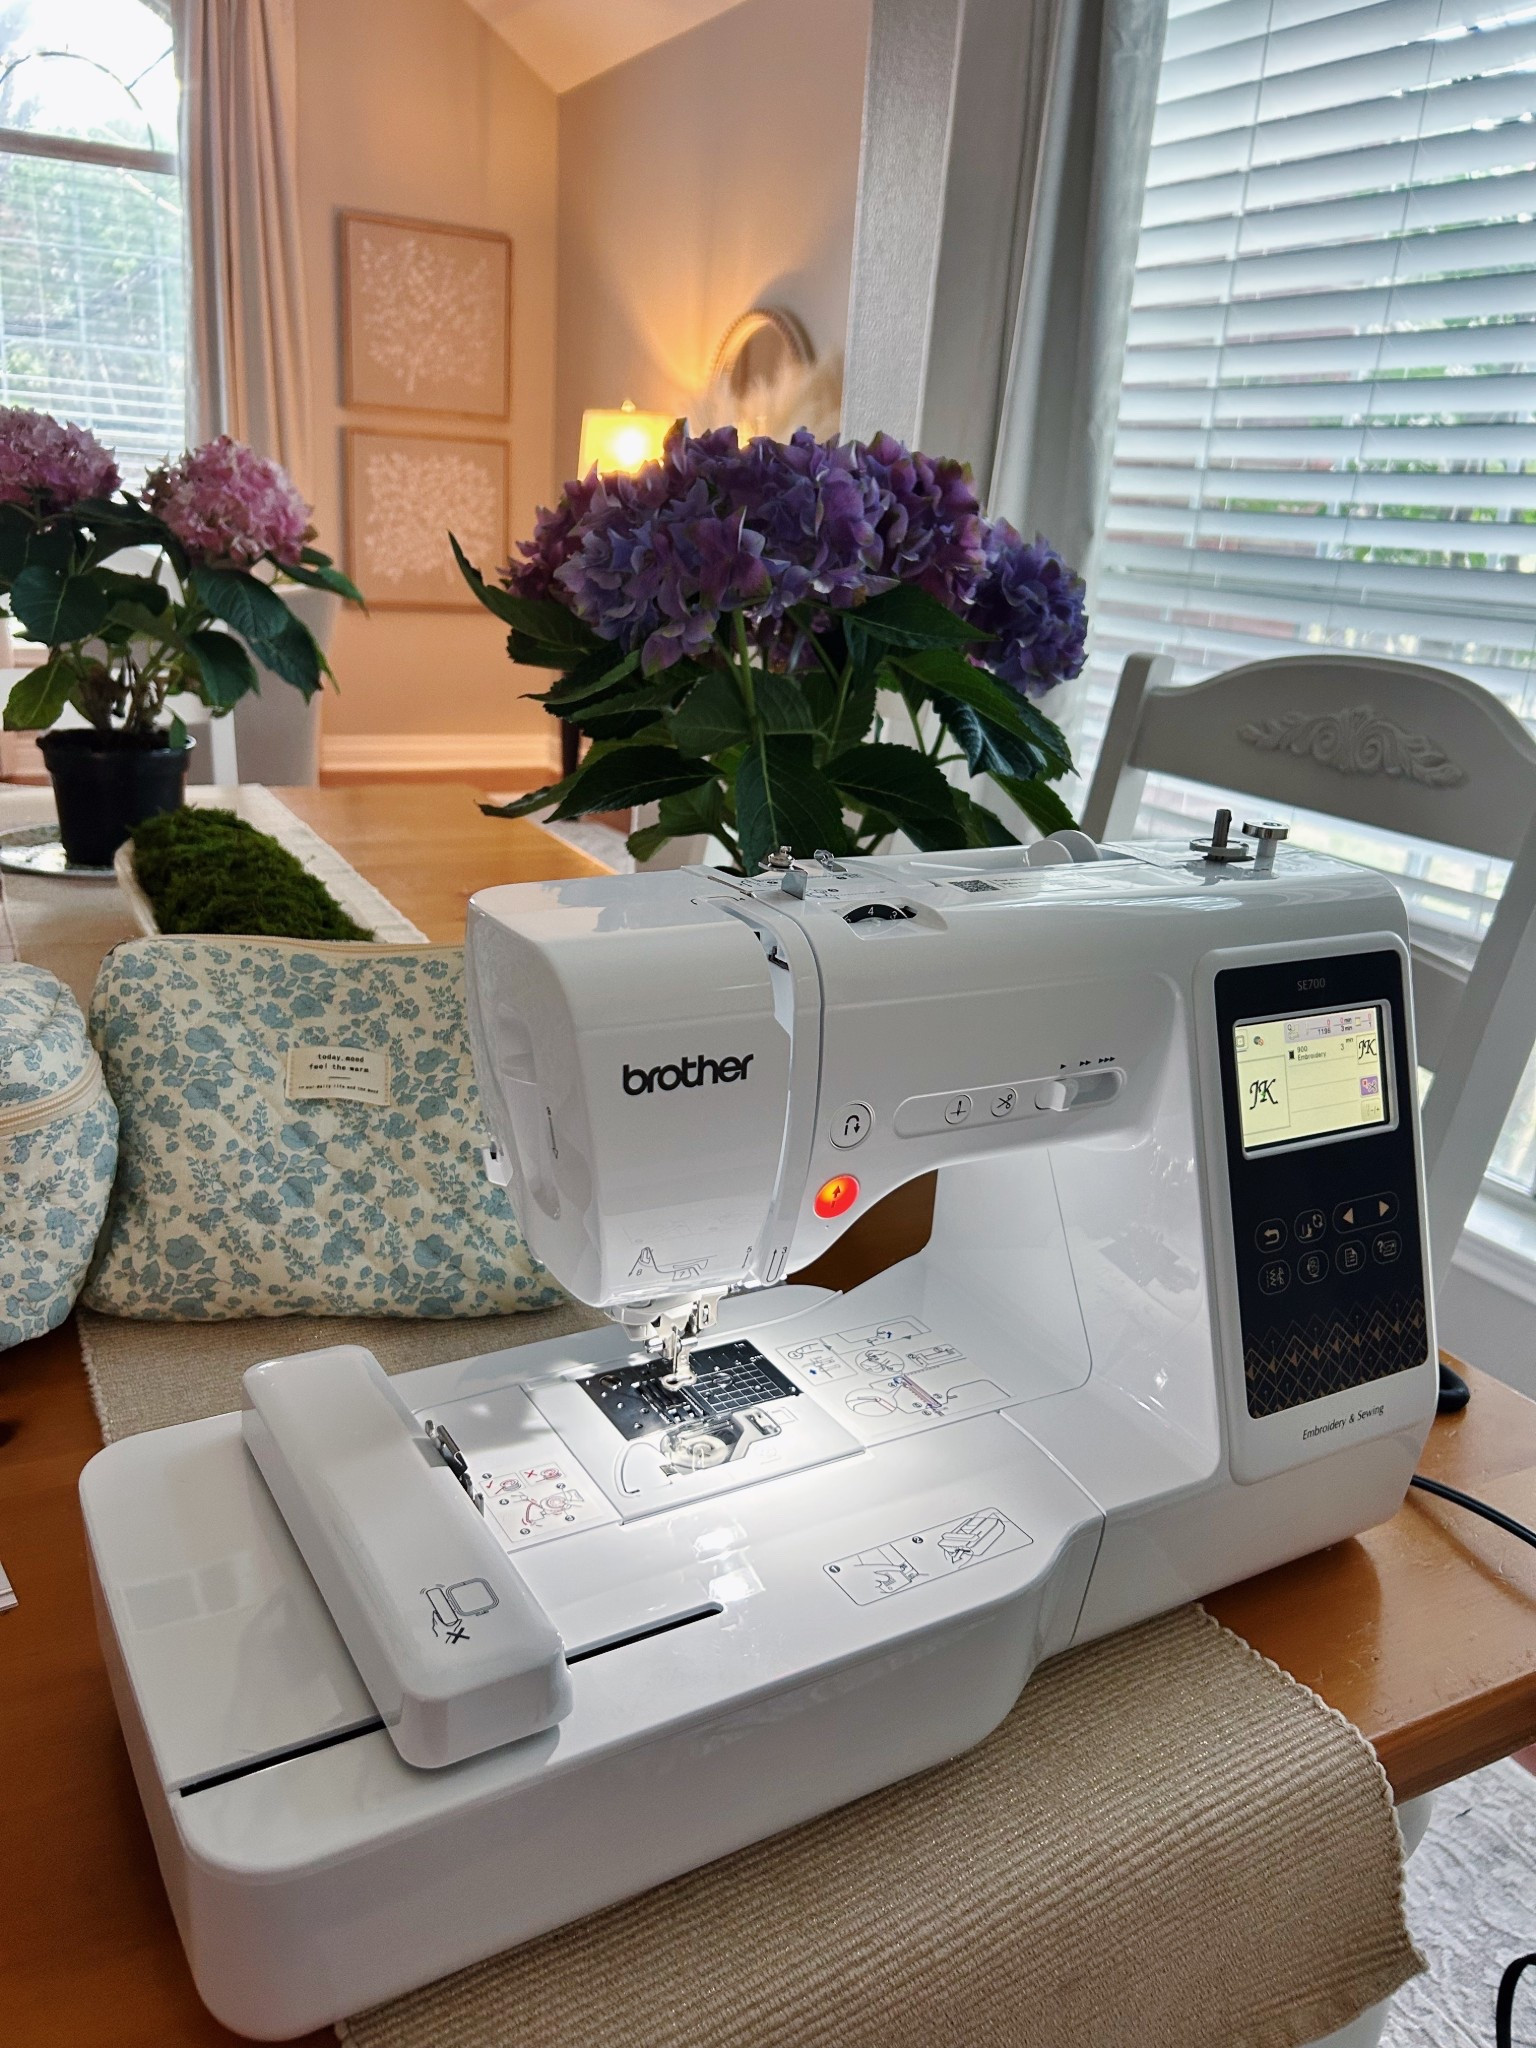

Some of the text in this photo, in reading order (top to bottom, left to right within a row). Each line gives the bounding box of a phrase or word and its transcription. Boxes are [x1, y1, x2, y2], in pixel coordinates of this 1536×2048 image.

[867, 906, 875, 916] 4
[1297, 977, 1326, 991] SE700
[1297, 1051, 1327, 1061] Embroidery
[1358, 1038, 1378, 1060] JK
[309, 1062, 328, 1071] feel
[332, 1063, 347, 1071] the
[622, 1053, 754, 1096] brother
[1249, 1078, 1279, 1110] JK
[1302, 1405, 1385, 1440] Embroidery & Sewing
